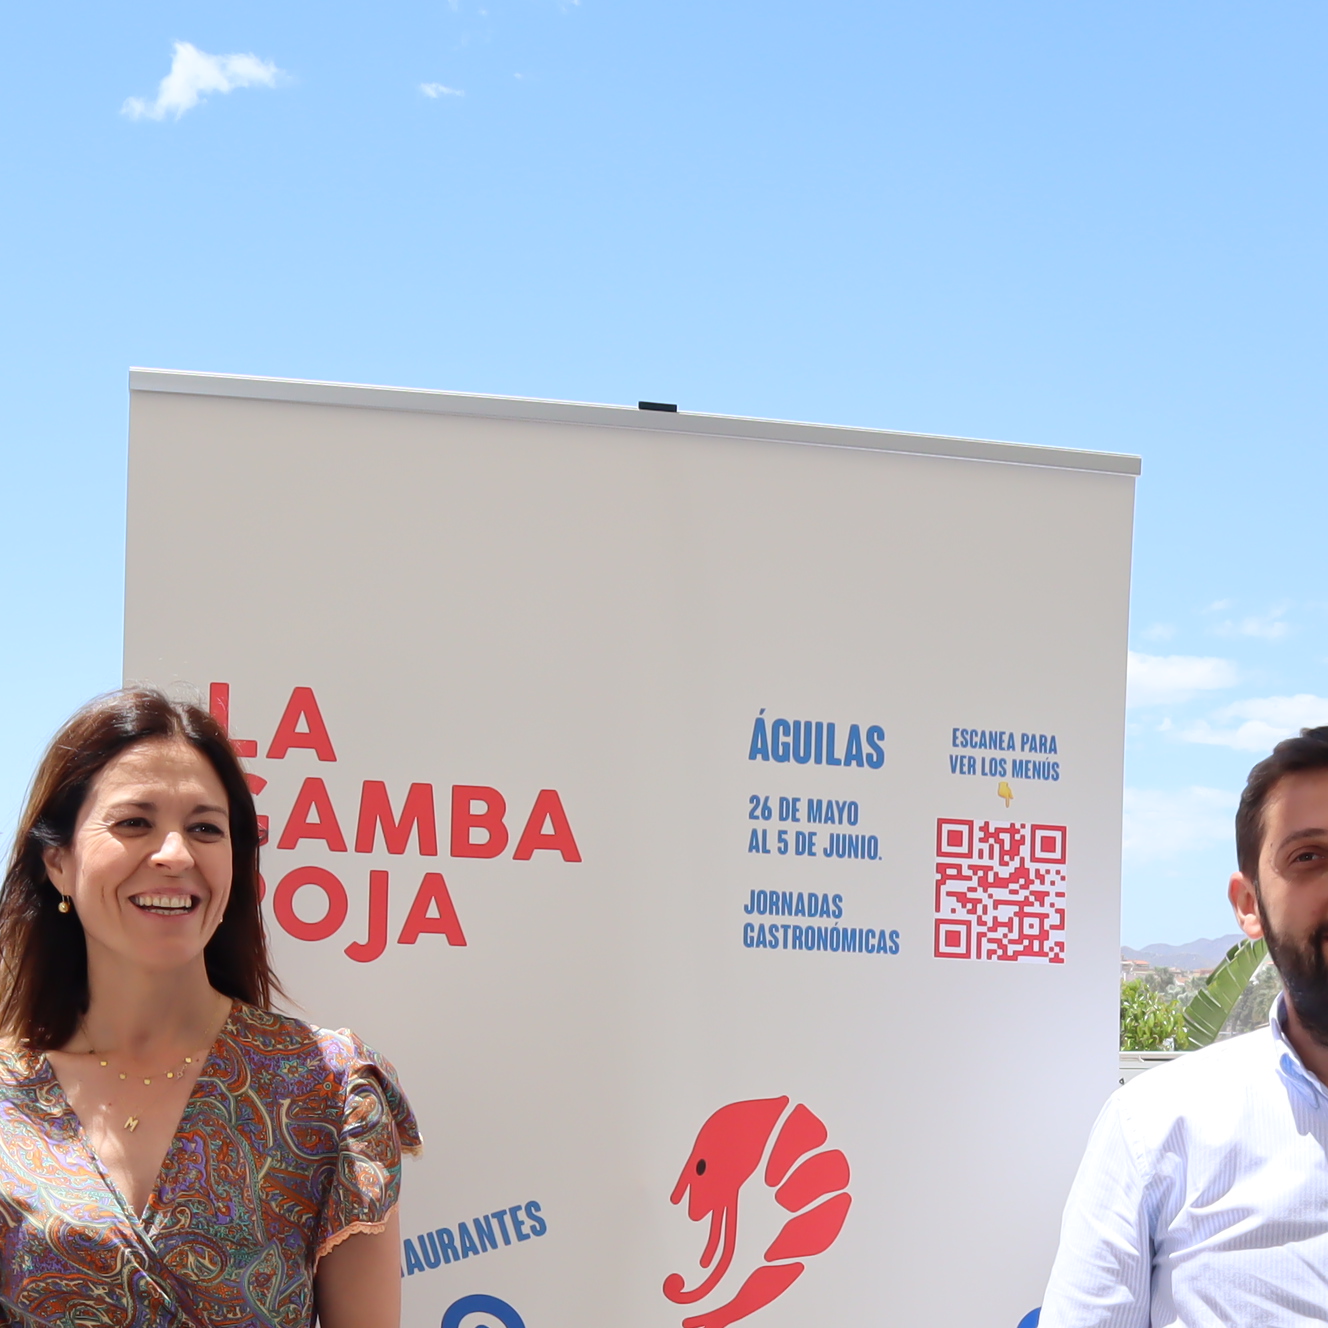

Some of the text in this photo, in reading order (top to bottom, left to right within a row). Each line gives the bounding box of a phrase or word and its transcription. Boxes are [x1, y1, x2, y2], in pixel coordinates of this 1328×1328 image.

[210, 682, 337, 762] LA
[748, 708, 885, 769] ÁGUILAS
[952, 727, 1057, 755] ESCANEA PARA
[949, 755, 1060, 781] VER LOS MENÚS
[749, 795, 859, 826] 26 DE MAYO
[748, 829, 882, 860] AL 5 DE JUNIO.
[257, 866, 467, 963] OJA
[744, 889, 843, 919] JORNADAS
[743, 922, 900, 955] GASTRONÓMICAS
[401, 1200, 547, 1278] AURANTES
